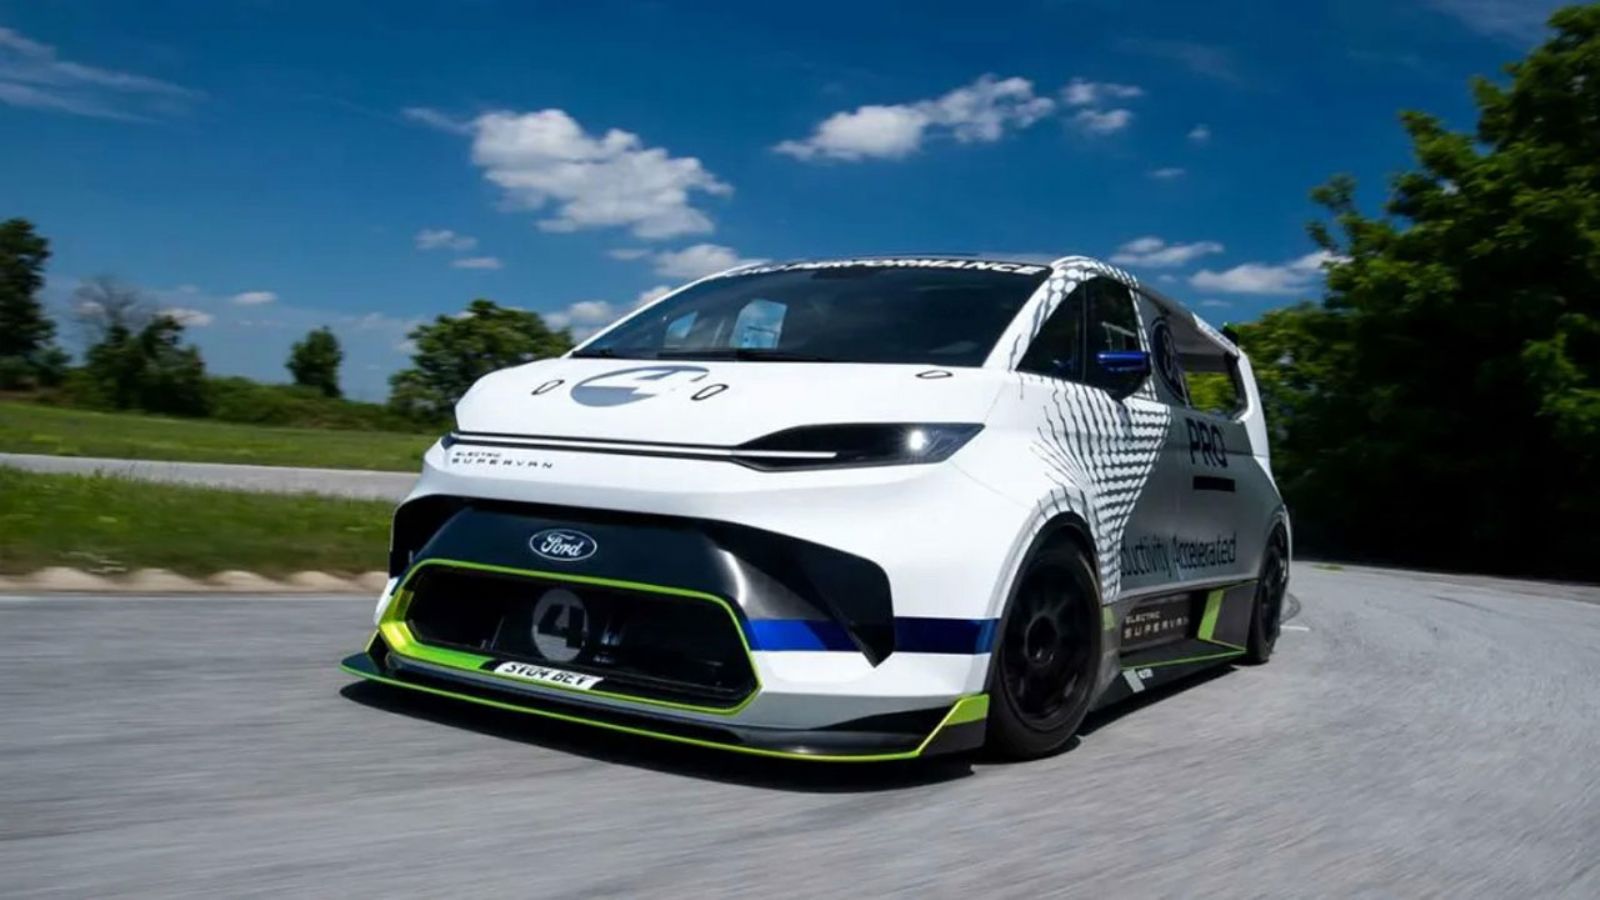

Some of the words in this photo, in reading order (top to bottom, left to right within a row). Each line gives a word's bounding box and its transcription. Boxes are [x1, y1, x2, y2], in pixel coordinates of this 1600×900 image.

[1185, 417, 1228, 467] PRO
[452, 458, 553, 468] SUPERVAN
[539, 531, 586, 557] Ford
[1172, 530, 1237, 570] Accelerated
[537, 602, 586, 651] 4
